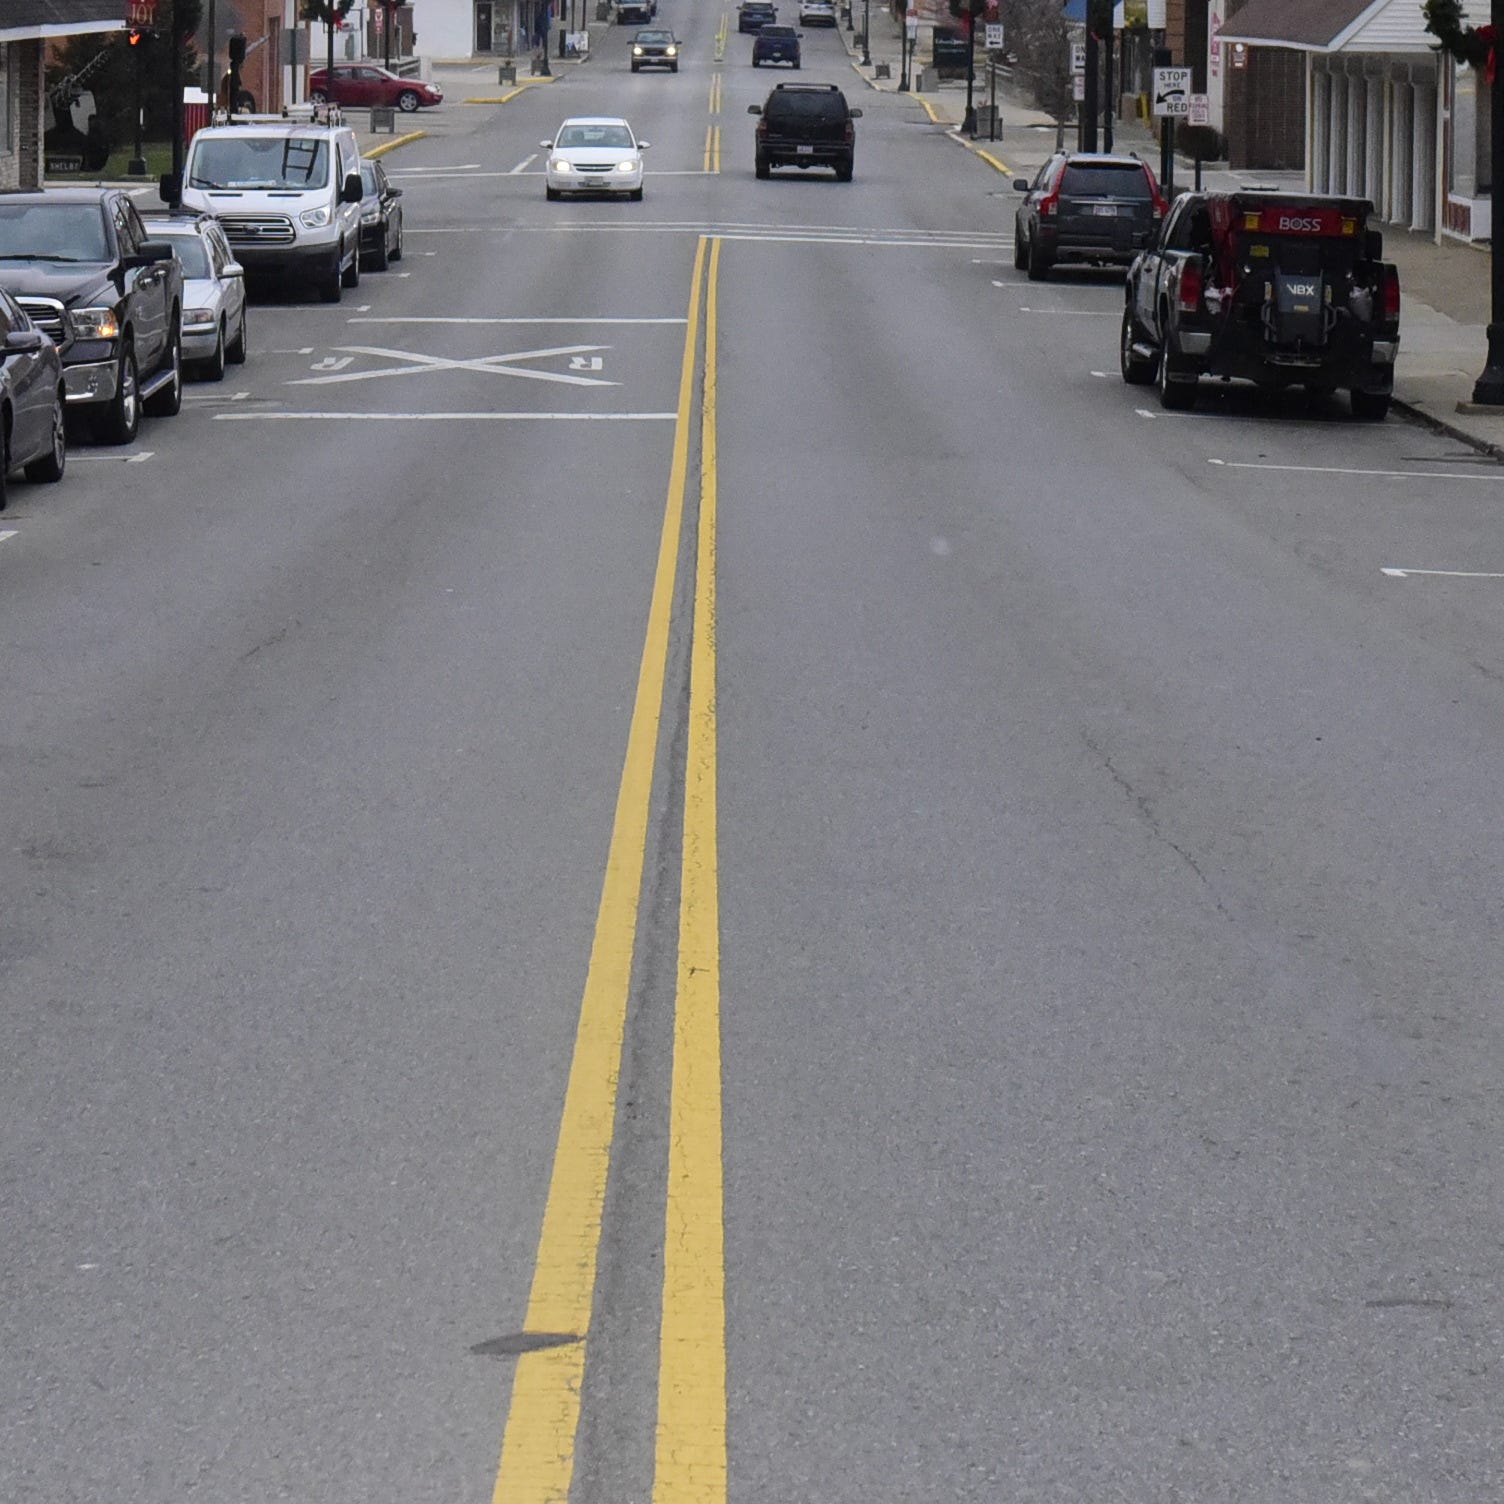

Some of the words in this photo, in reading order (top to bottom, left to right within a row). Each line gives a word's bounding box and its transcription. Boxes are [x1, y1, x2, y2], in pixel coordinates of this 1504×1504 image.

[129, 3, 156, 25] JOY
[1160, 71, 1187, 81] STOP
[1167, 103, 1187, 112] RED
[1279, 217, 1322, 231] BOSS
[1287, 284, 1314, 296] VBX
